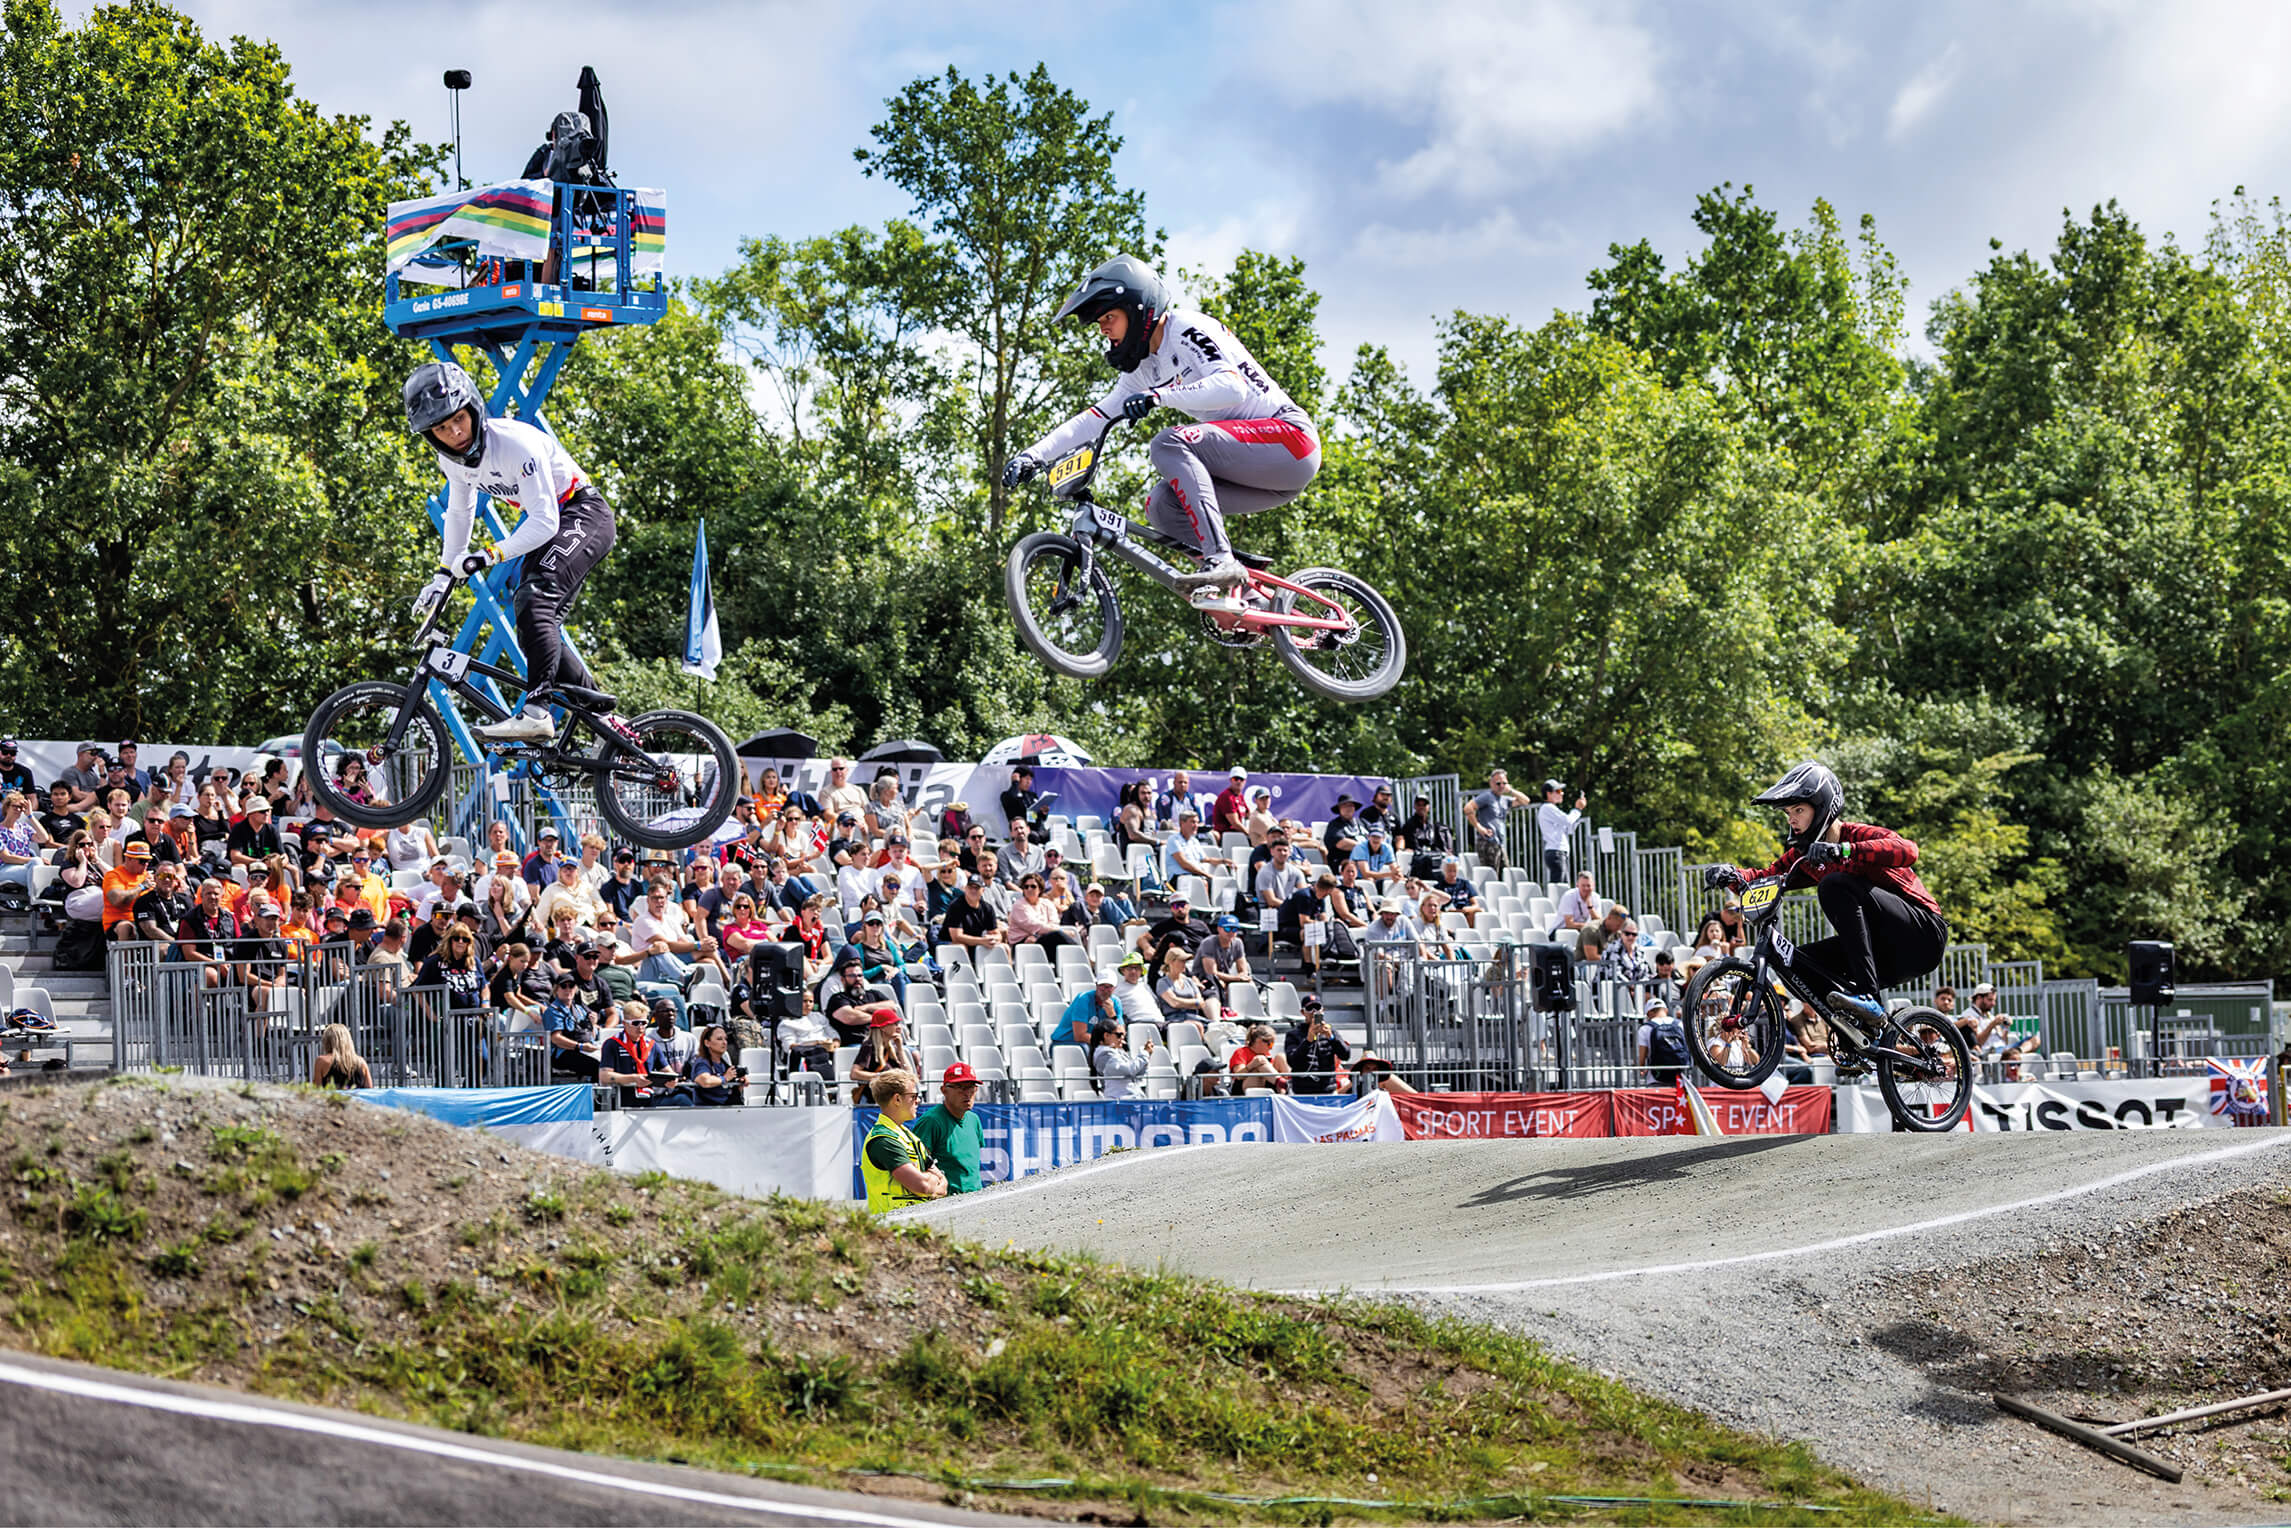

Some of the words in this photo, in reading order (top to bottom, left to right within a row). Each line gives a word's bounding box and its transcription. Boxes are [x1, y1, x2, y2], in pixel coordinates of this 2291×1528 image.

[1181, 326, 1222, 362] KTM
[1055, 456, 1083, 481] 591
[1099, 509, 1122, 529] 591
[539, 518, 587, 571] FLY
[441, 652, 457, 670] 3
[1748, 888, 1770, 904] 621
[1776, 934, 1791, 956] 621
[1415, 1110, 1497, 1136] SPORT
[1504, 1109, 1579, 1135] EVENT
[1648, 1105, 1722, 1130] SPT
[1728, 1103, 1798, 1129] EVENT
